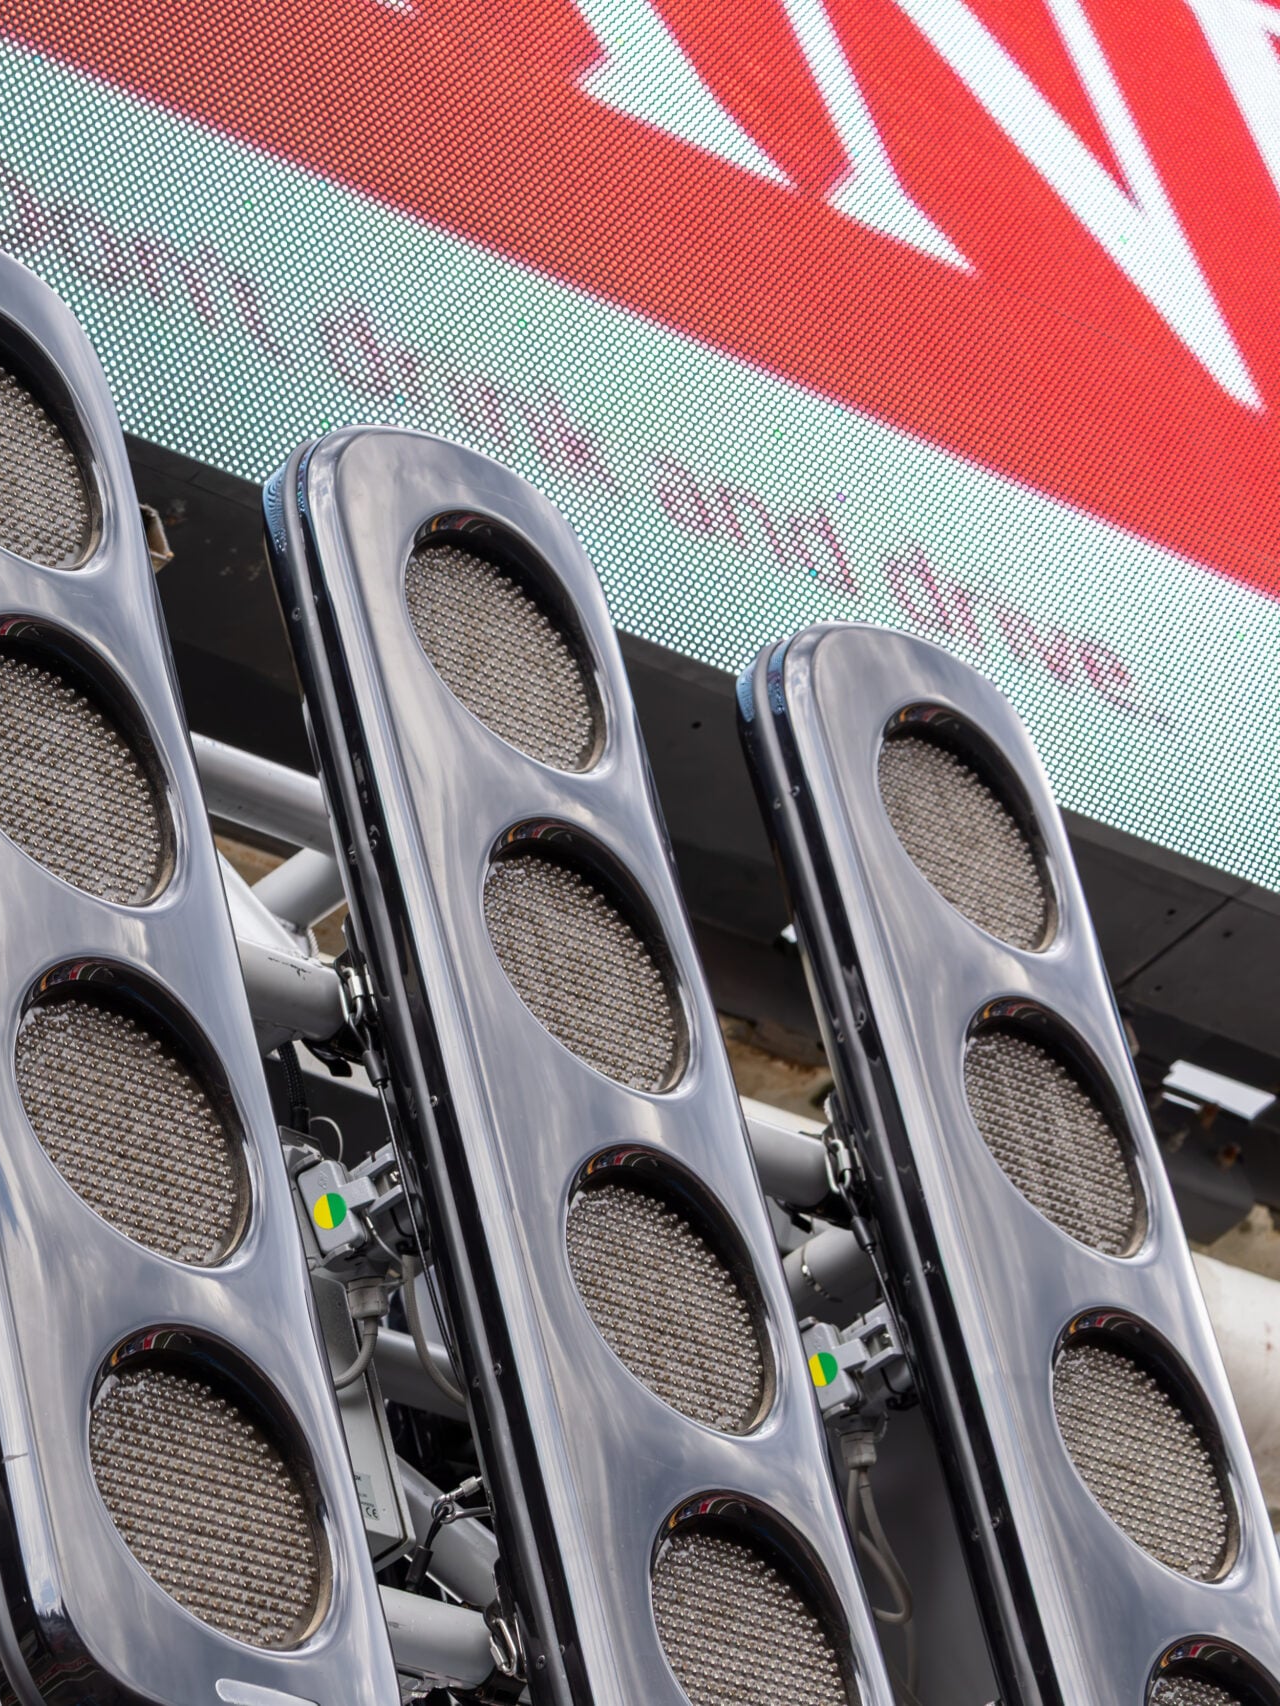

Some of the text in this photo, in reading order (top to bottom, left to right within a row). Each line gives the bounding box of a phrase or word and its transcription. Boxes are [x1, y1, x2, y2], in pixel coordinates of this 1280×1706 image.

[318, 302, 622, 502] drink
[648, 447, 861, 599] and
[883, 546, 1179, 733] drive.
